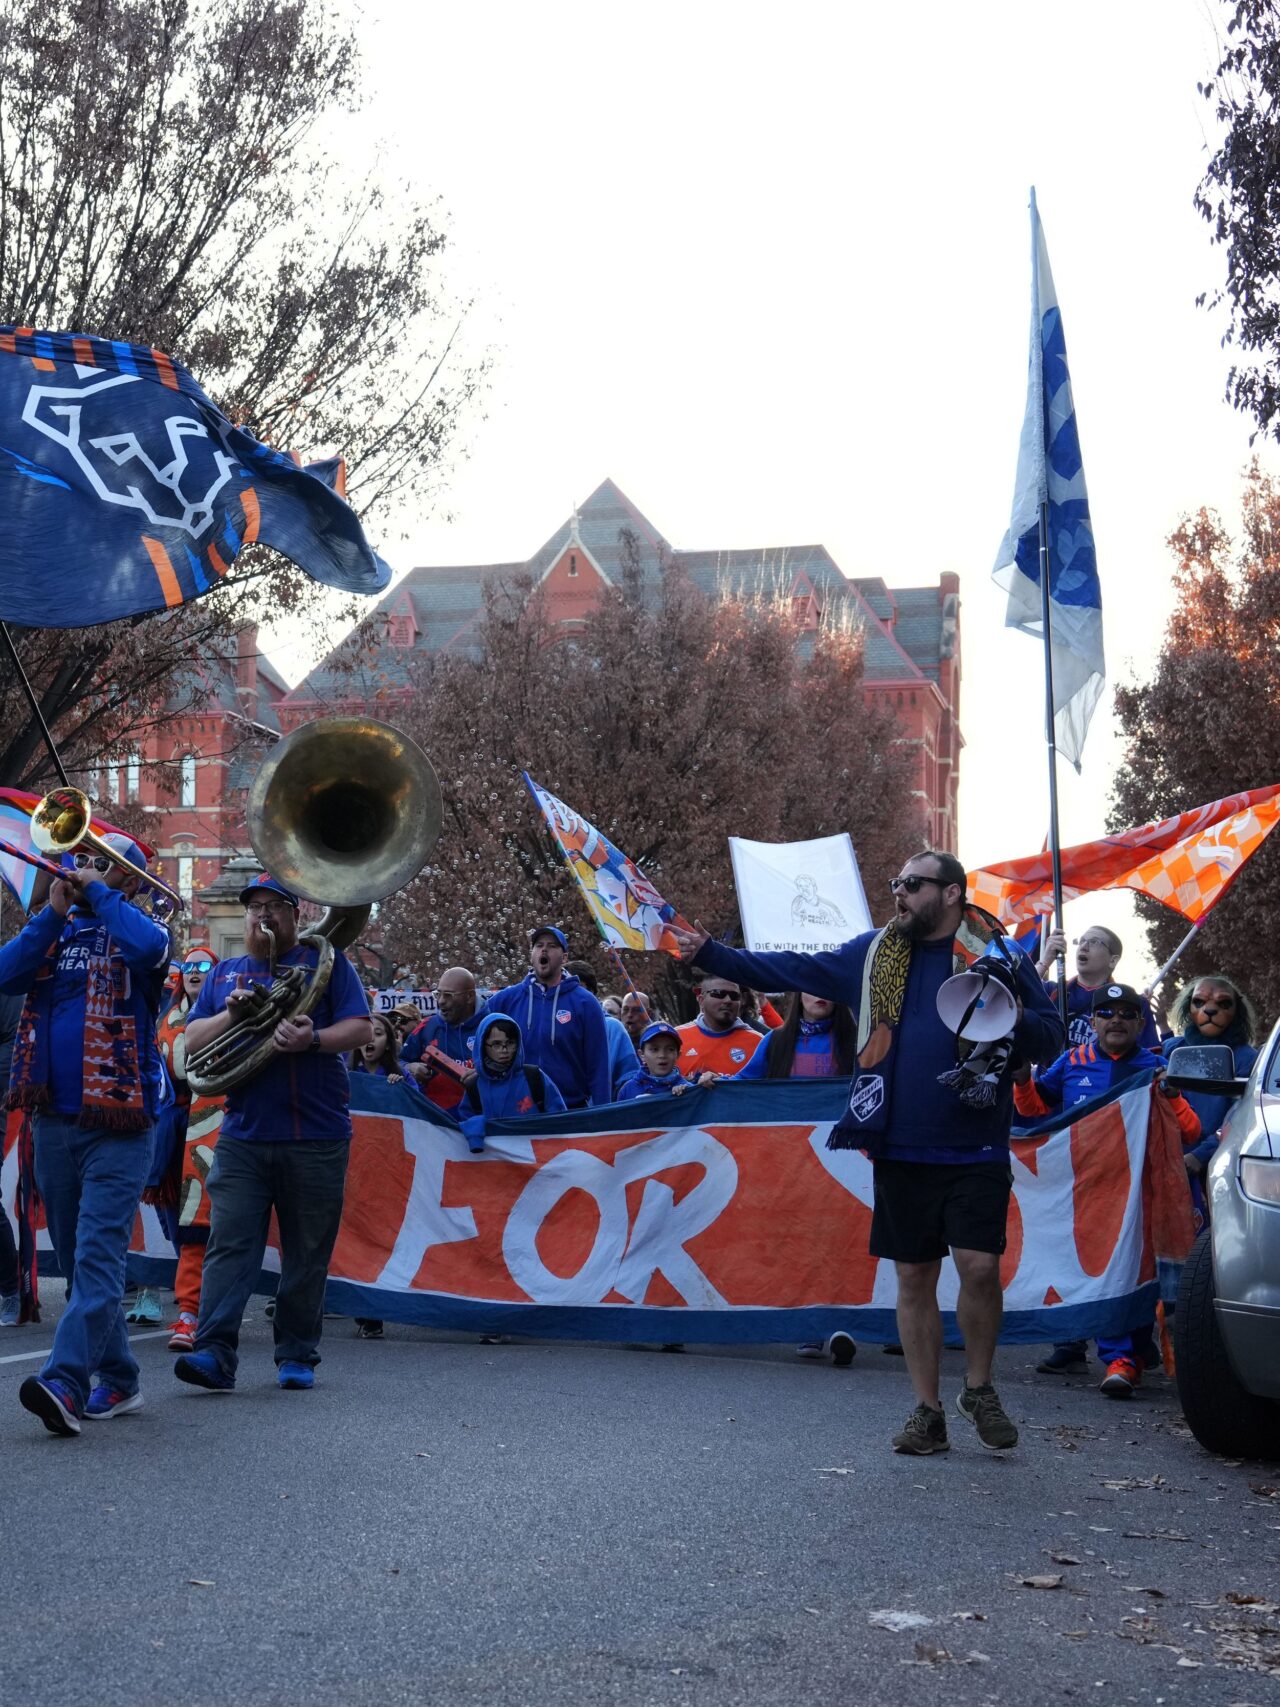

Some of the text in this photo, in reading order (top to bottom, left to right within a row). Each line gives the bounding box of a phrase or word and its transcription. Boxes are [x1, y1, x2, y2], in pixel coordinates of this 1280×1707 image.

[755, 942, 771, 951] DIE
[773, 942, 798, 951] WITH
[801, 942, 820, 951] THE
[852, 1078, 882, 1106] CINCINNATI
[376, 1116, 730, 1306] FOR
